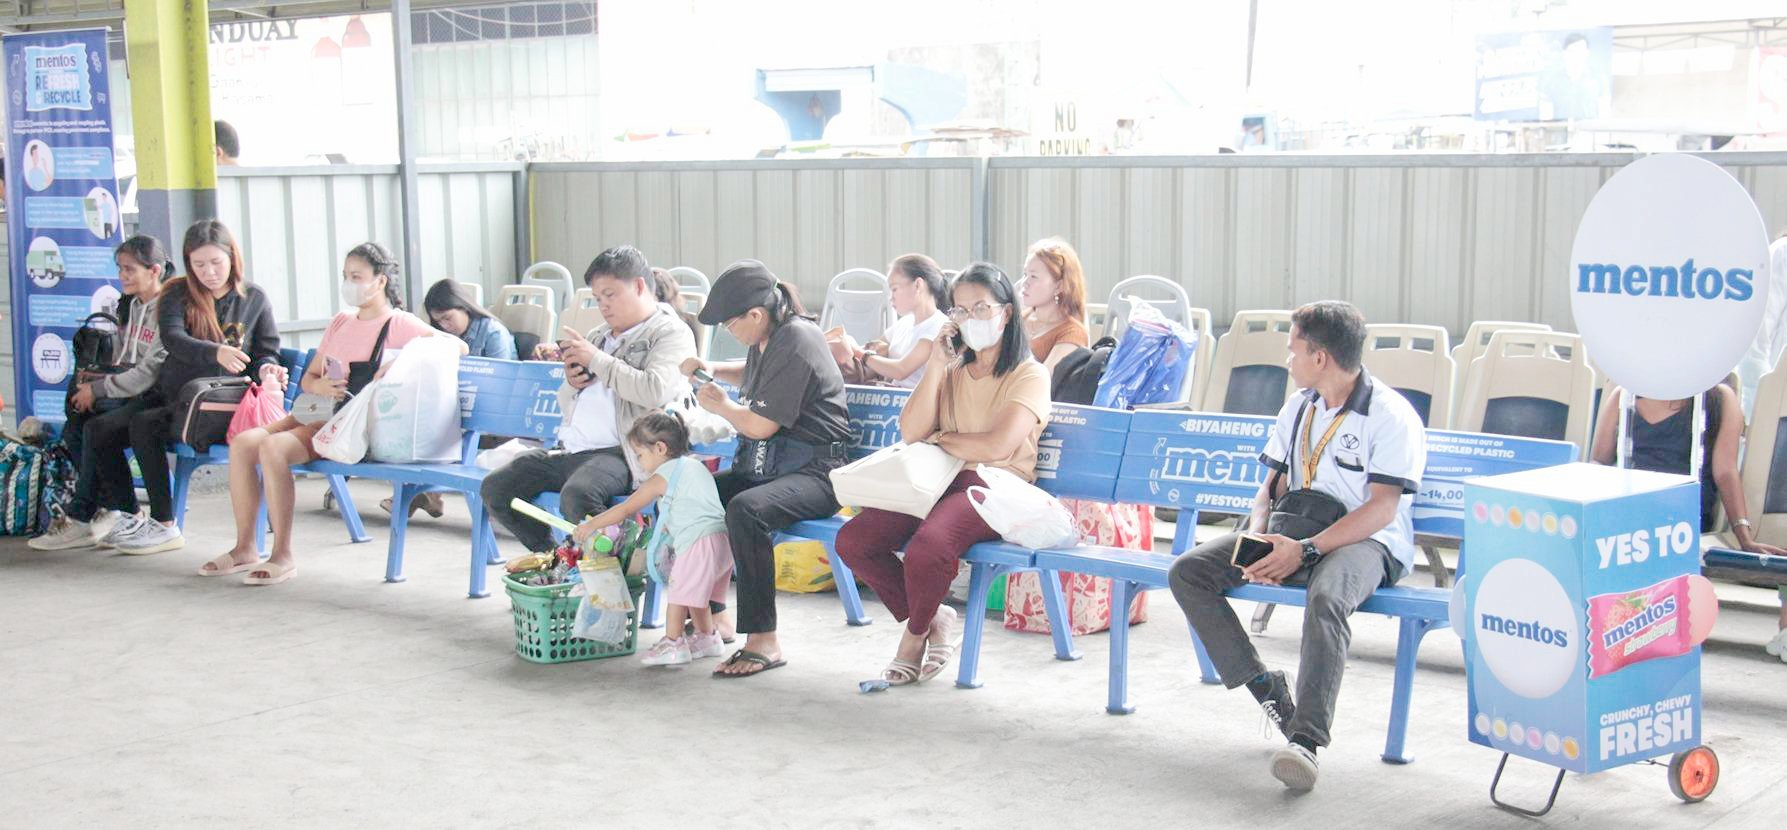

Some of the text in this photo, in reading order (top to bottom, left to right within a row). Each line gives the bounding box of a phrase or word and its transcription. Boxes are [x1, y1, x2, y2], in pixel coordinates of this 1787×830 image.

[35, 54, 77, 69] mentos
[209, 46, 272, 66] IGHT
[35, 73, 81, 91] REFRESH
[44, 90, 81, 104] RECYCLE
[1054, 101, 1076, 132] NO
[1577, 258, 1753, 301] mentos
[1054, 414, 1087, 425] PLASTIC
[1186, 419, 1265, 438] BIYAHENG
[1237, 444, 1256, 452] WITH
[1474, 447, 1515, 459] PLASTIC
[1161, 447, 1264, 487] men
[1595, 521, 1693, 570] YES TO
[1481, 613, 1567, 648] mentos
[1603, 596, 1677, 649] mentos
[1600, 694, 1692, 726] CRUNCHY, CHEWY
[1600, 707, 1692, 760] FRESH
